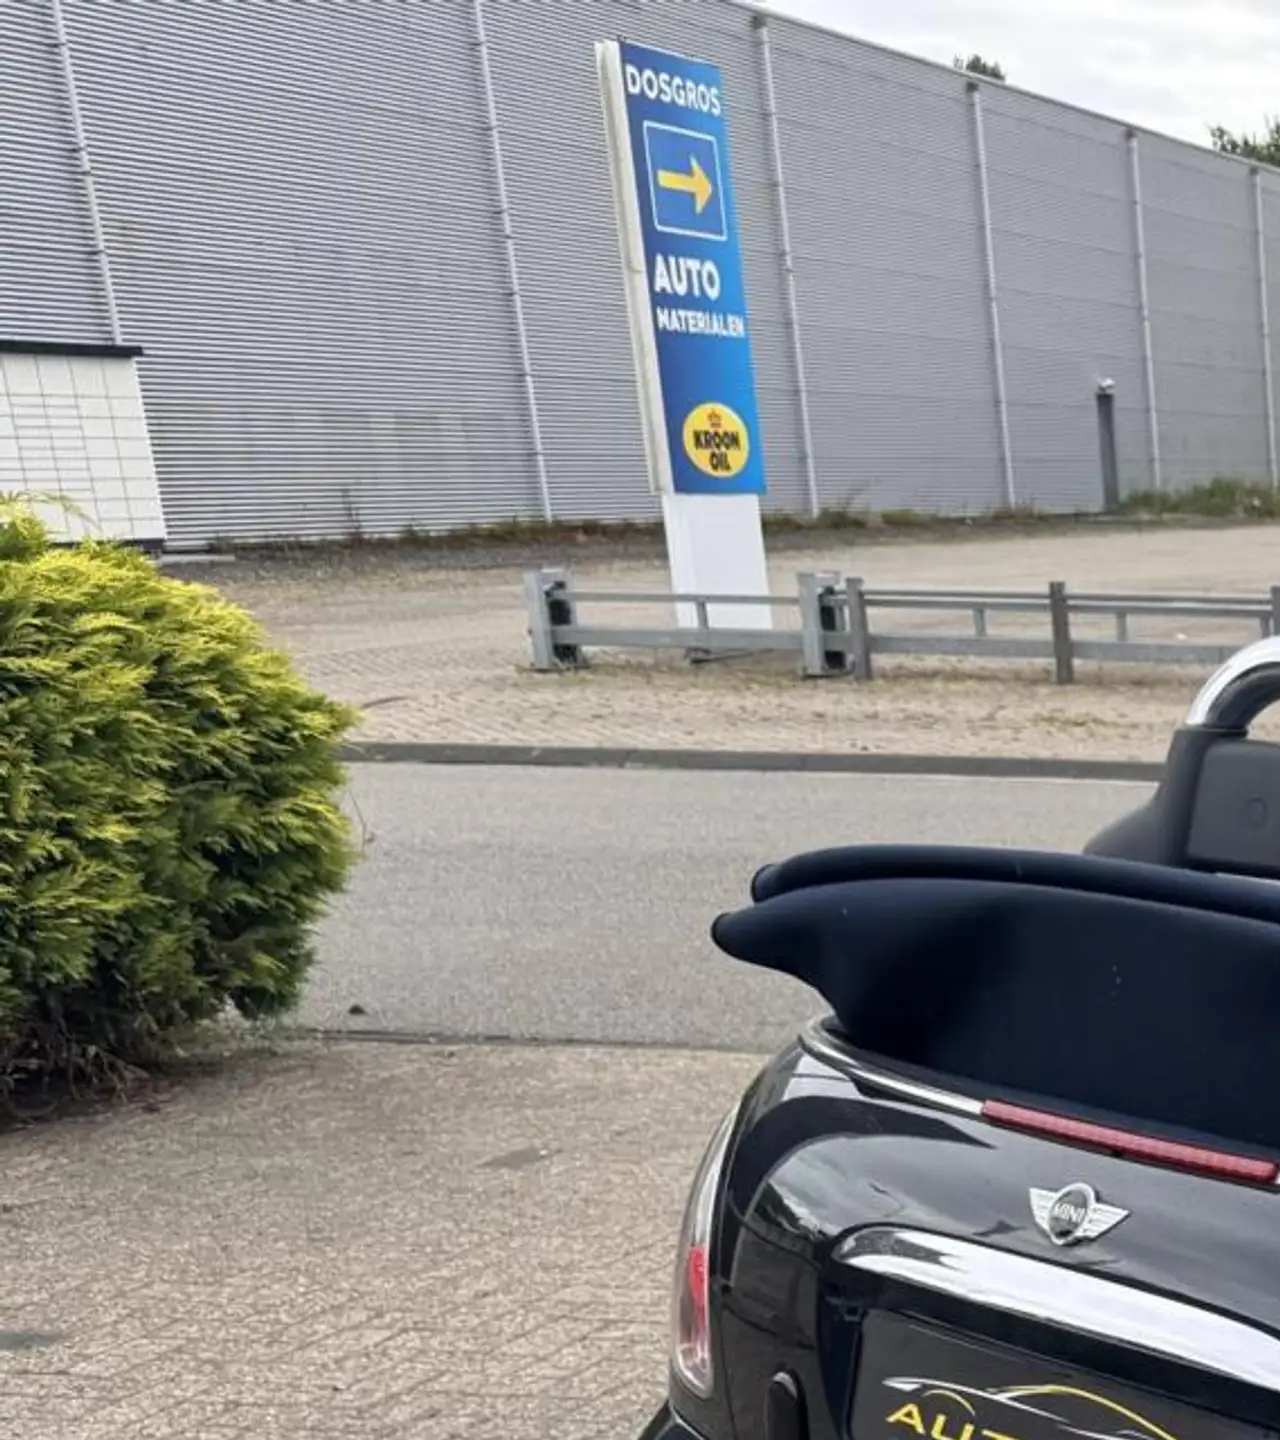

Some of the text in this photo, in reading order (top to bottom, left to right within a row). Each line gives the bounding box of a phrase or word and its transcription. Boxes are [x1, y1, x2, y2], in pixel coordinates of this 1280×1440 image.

[625, 64, 721, 117] DOSGROS
[655, 253, 720, 301] AUTO
[656, 306, 745, 338] MATERIALEN
[693, 430, 741, 451] KROON
[709, 451, 732, 472] OIL
